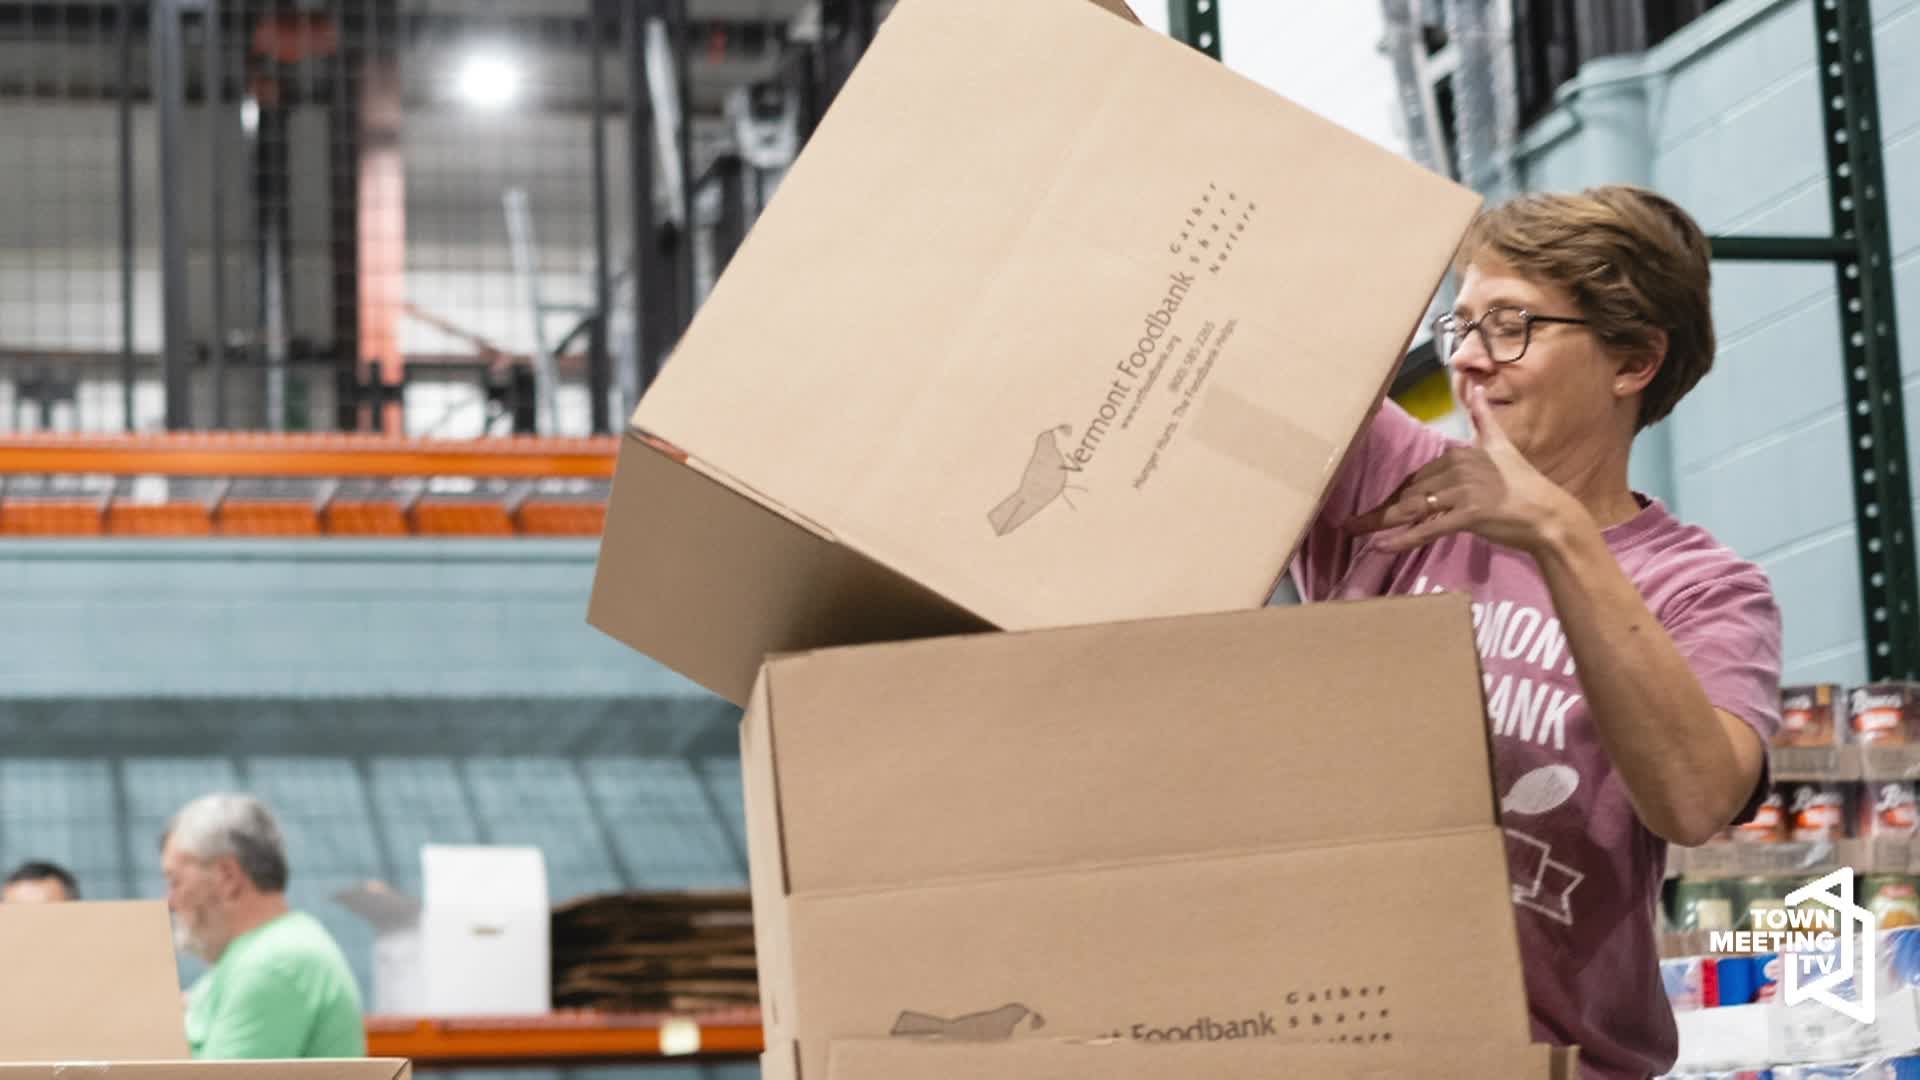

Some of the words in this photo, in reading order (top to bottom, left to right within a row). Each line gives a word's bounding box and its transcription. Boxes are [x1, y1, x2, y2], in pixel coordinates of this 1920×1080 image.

[1169, 182, 1217, 254] Gather
[1207, 201, 1256, 274] Nurture
[1057, 378, 1131, 473] Vermont
[1114, 270, 1195, 379] Foodbank
[1285, 984, 1386, 1005] Gather
